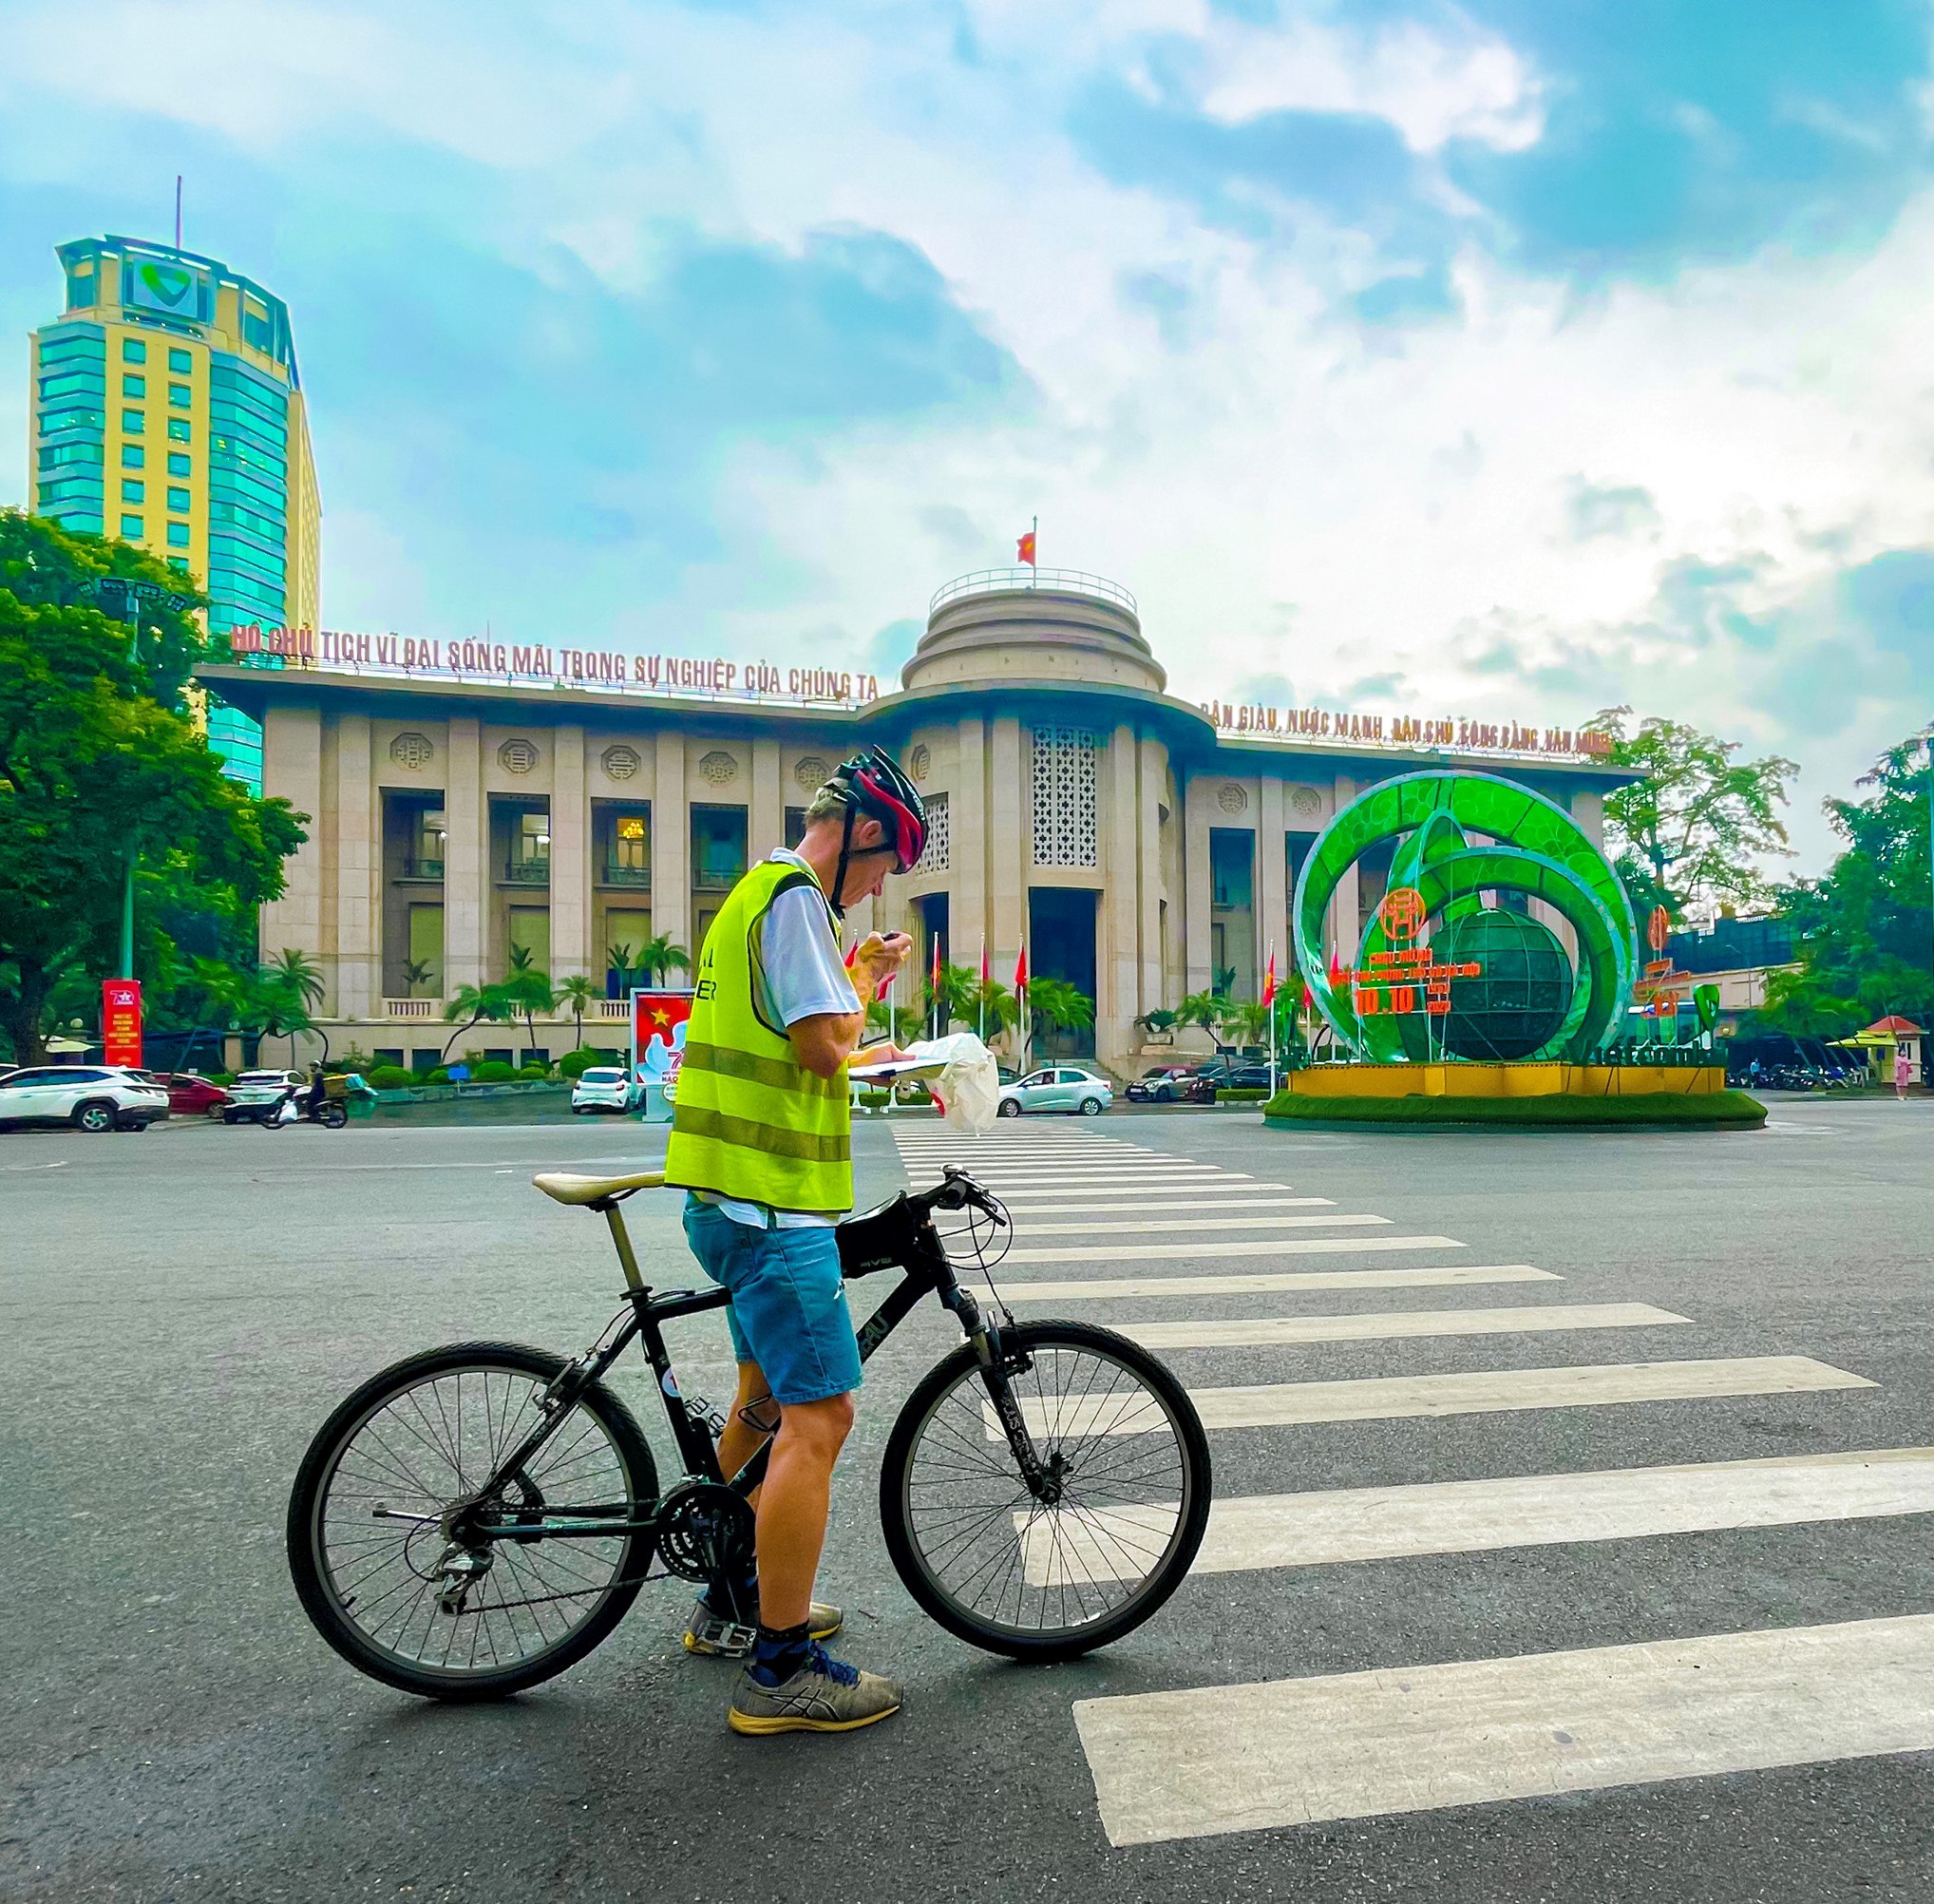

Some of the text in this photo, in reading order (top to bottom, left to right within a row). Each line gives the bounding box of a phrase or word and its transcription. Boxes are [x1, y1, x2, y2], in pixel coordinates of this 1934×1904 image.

[320, 631, 370, 664] TỊCH
[376, 632, 398, 665] VĨ
[404, 638, 440, 669] ĐẠI
[447, 636, 506, 674] SỐNG
[512, 643, 553, 676] MÃI
[559, 649, 625, 681] TRONG
[635, 654, 661, 688] SỰ
[666, 657, 736, 691] NGHIỆP
[745, 658, 781, 695] CỦA
[789, 666, 852, 698] CHÚNG
[857, 674, 879, 700] TA
